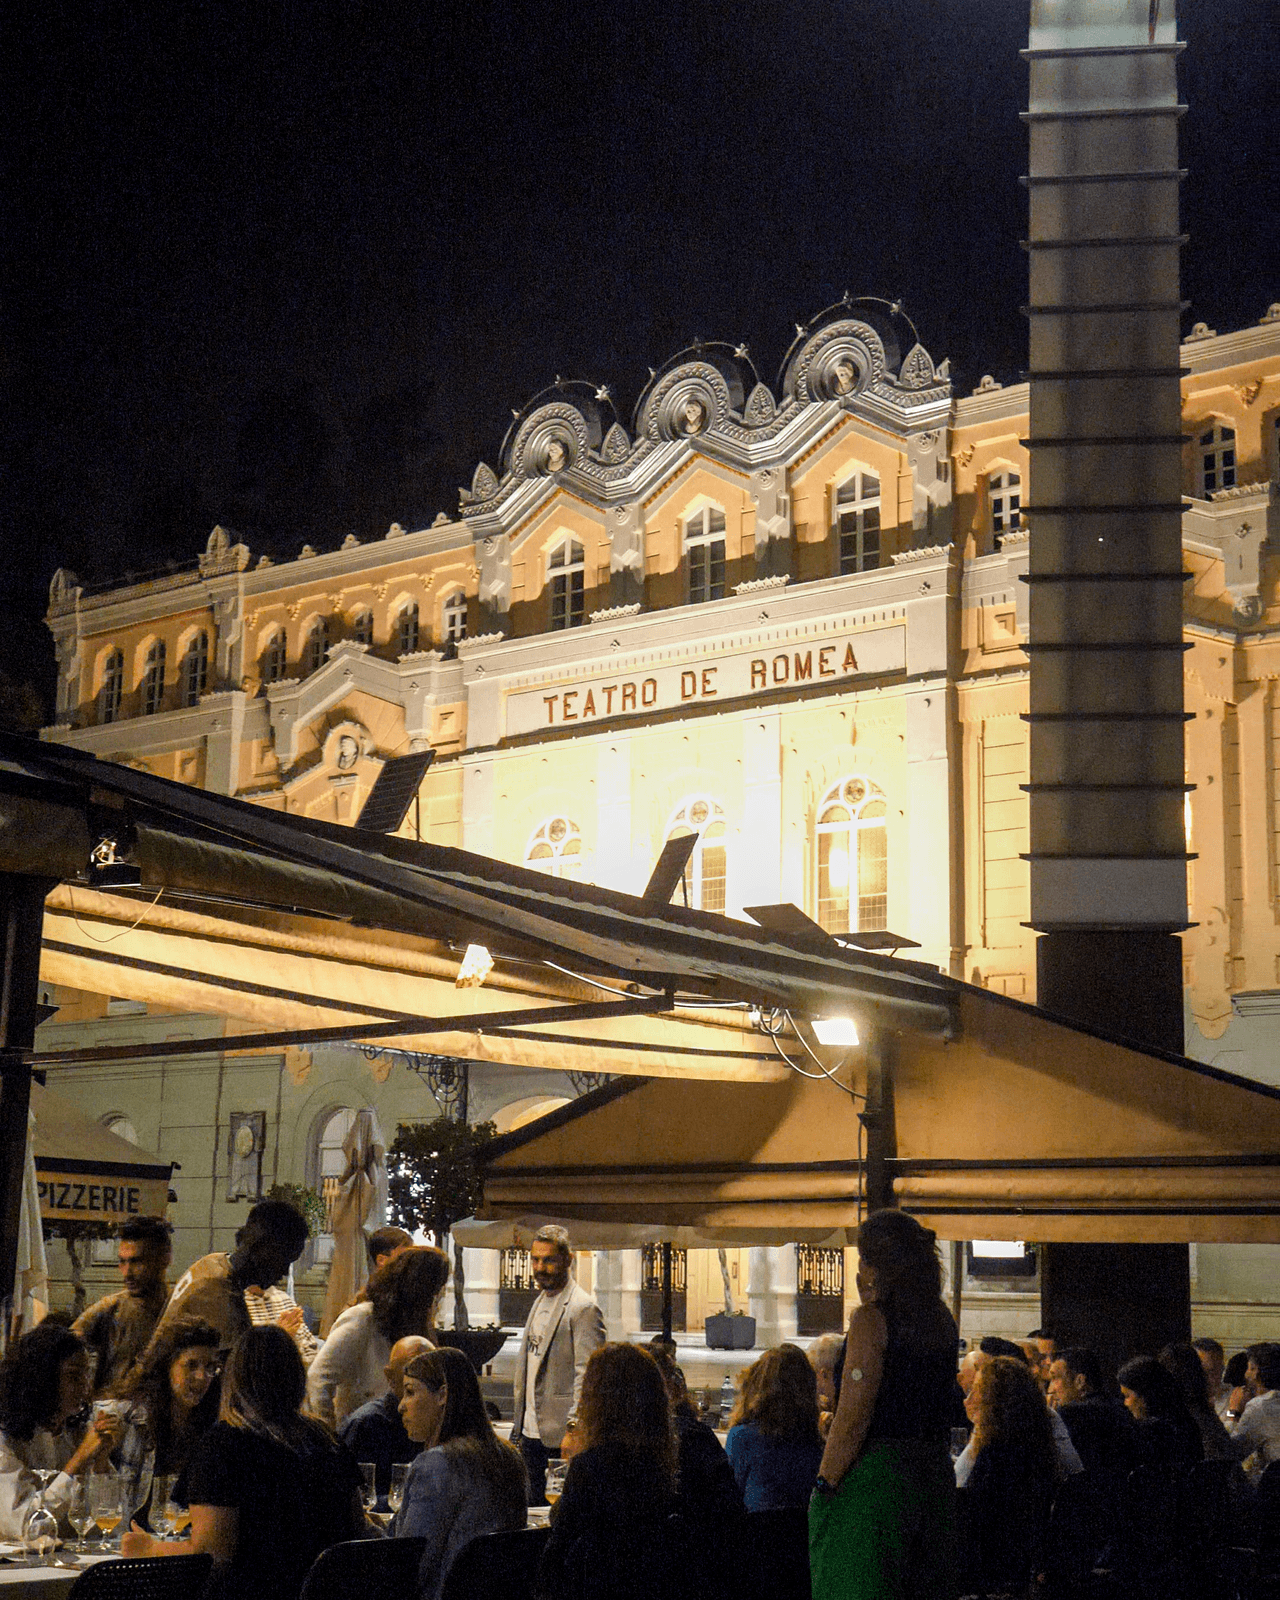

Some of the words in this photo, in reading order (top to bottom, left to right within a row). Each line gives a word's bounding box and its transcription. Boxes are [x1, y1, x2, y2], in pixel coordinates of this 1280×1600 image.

[543, 678, 657, 723] TEATRO
[681, 667, 717, 701] DE
[750, 642, 858, 690] ROMEA
[37, 1181, 140, 1214] PIZZERIE
